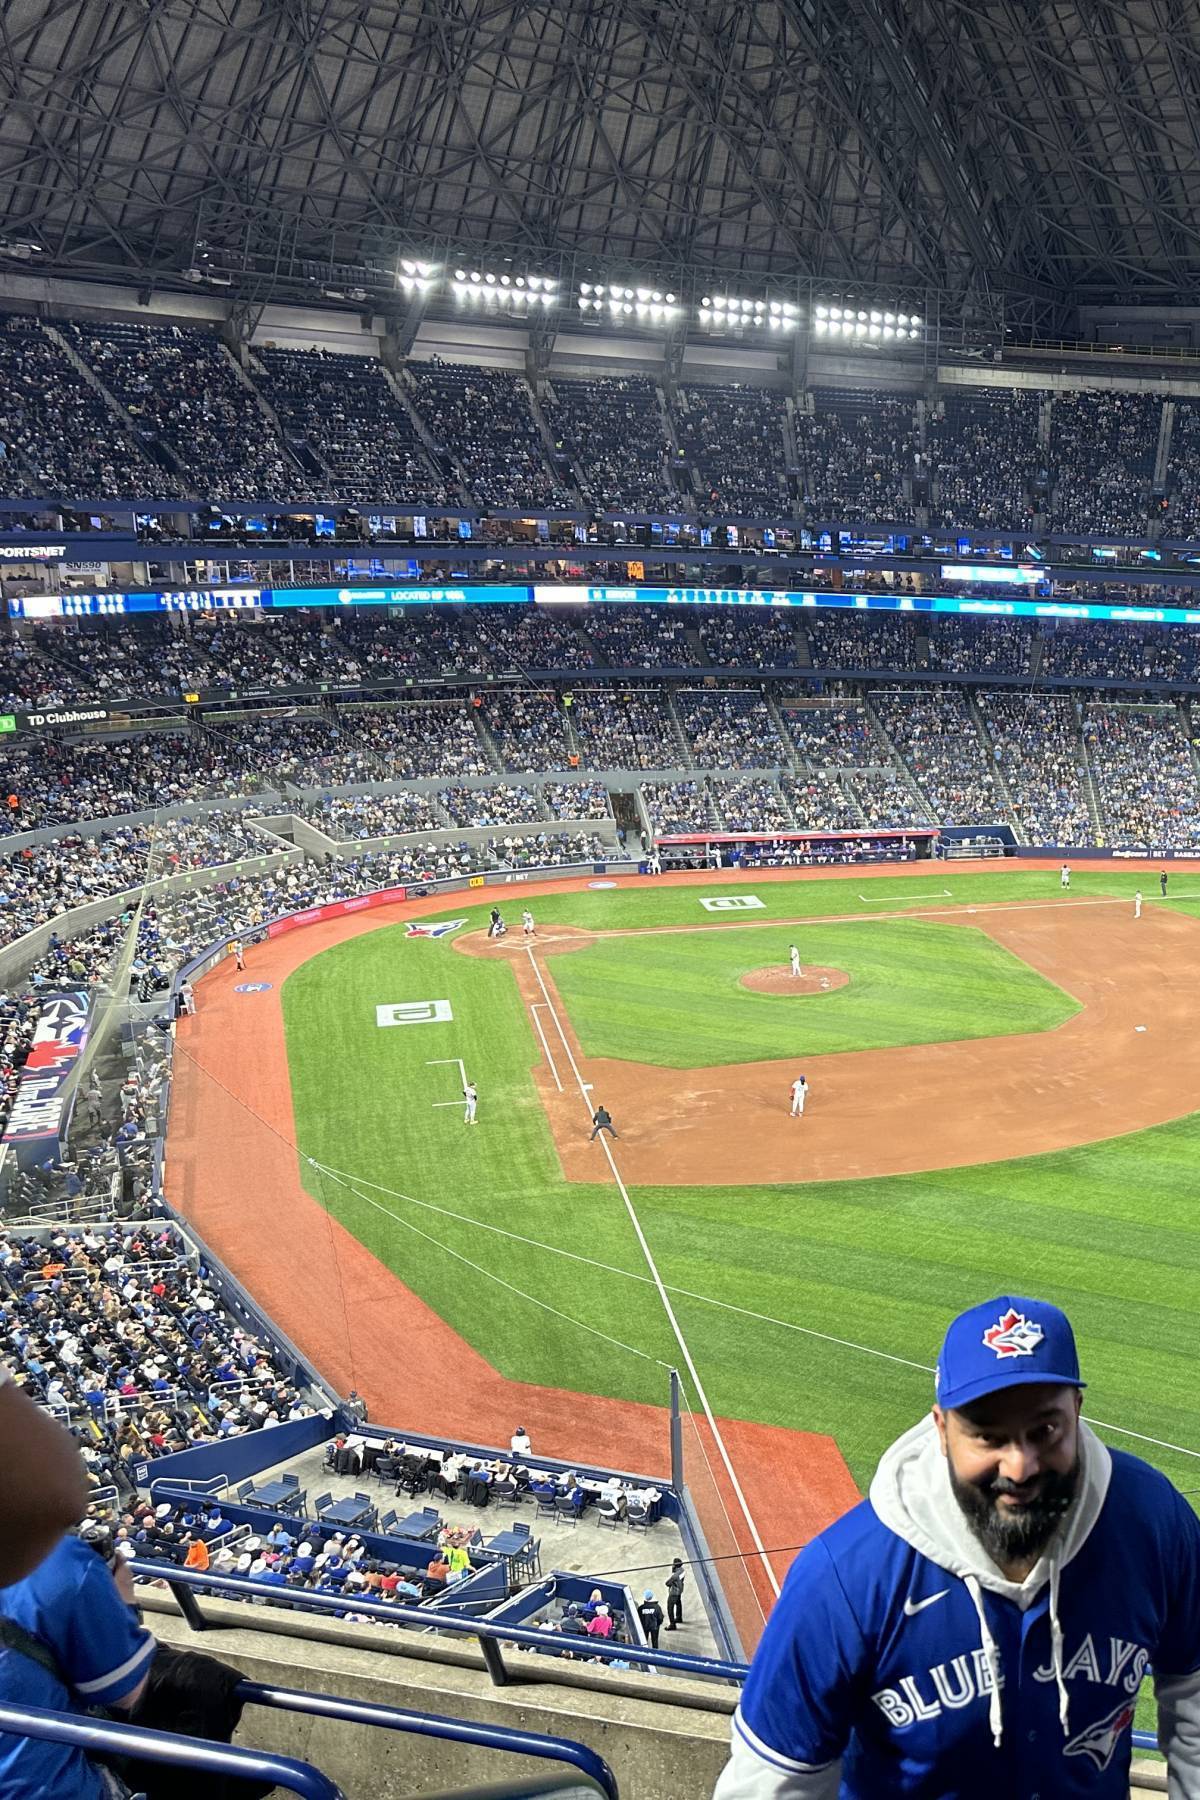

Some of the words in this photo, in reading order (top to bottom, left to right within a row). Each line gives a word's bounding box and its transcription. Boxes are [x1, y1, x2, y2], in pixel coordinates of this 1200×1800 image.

[27, 715, 45, 727] TD
[46, 710, 107, 725] Clubhouse
[5, 1097, 64, 1135] CORE
[871, 1646, 1005, 1729] BLUE
[1032, 1633, 1149, 1694] JAYS
